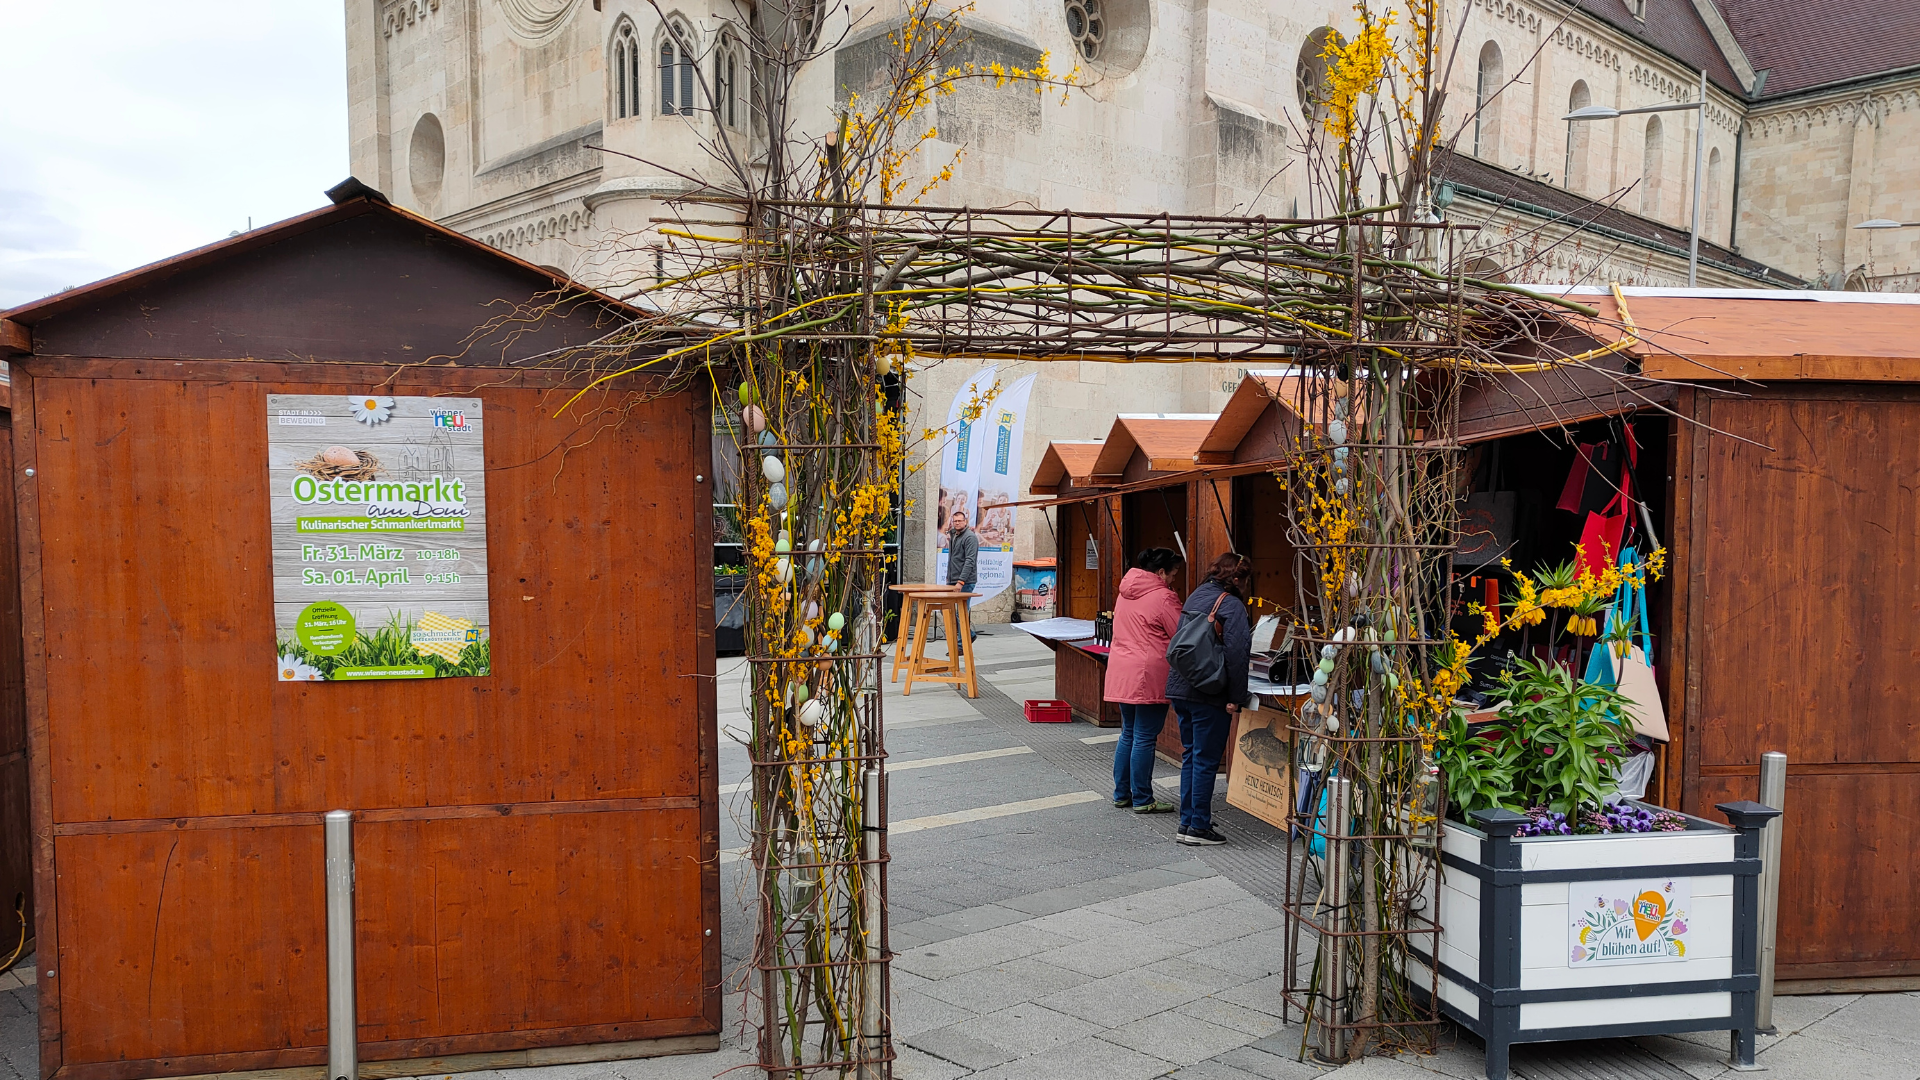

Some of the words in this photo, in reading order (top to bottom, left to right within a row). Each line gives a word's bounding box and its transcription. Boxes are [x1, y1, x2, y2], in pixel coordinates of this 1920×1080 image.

[430, 408, 463, 416] wiener
[434, 414, 464, 427] neu
[448, 424, 471, 432] stadt
[293, 476, 464, 502] Ostermarkt
[368, 504, 407, 516] am
[410, 499, 469, 516] Dom
[301, 519, 369, 530] Kulinarischer
[370, 518, 462, 529] Schmankerlmarkt
[302, 545, 323, 560] Fr.
[326, 545, 355, 561] 31.
[359, 544, 403, 560] März
[416, 549, 459, 560] 10-18h
[303, 569, 329, 584] Sa.
[333, 569, 361, 584] 01.
[365, 568, 410, 588] April
[424, 573, 460, 584] 9-15h
[346, 668, 424, 677] www.wiener-neustadt.at
[1245, 774, 1259, 789] HEINZ
[1615, 925, 1634, 939] Wir
[1602, 941, 1637, 956] blühen
[1639, 939, 1661, 954] auf!
